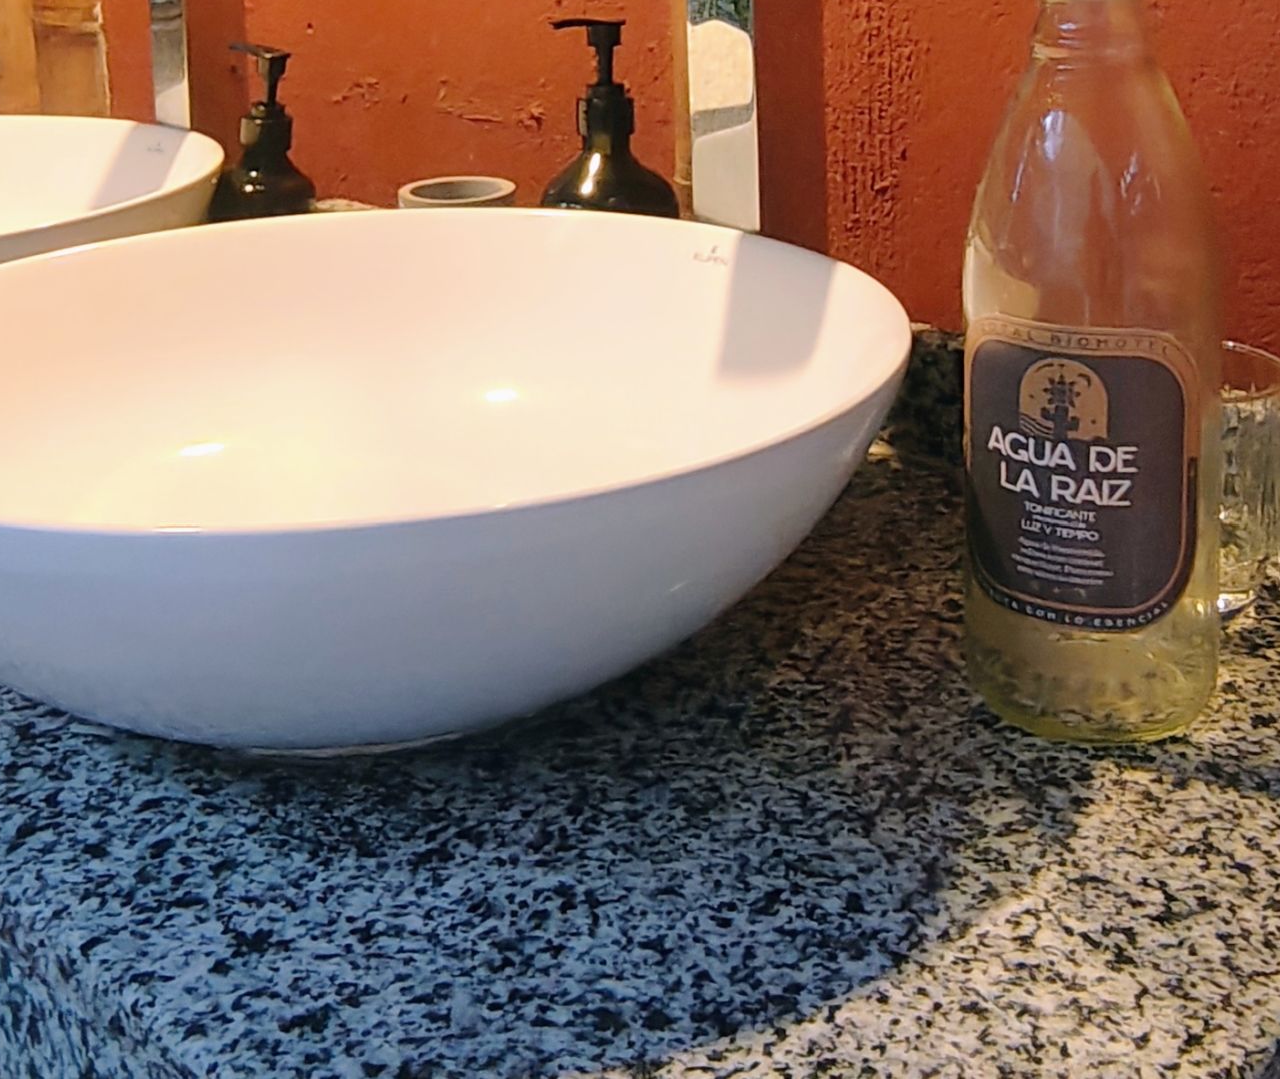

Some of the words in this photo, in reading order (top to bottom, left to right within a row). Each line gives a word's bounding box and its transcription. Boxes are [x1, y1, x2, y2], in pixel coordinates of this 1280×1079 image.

[987, 425, 1077, 471] AGUA
[1088, 445, 1139, 473] DE
[1000, 460, 1041, 499] LA
[1051, 474, 1132, 507] RAIZ
